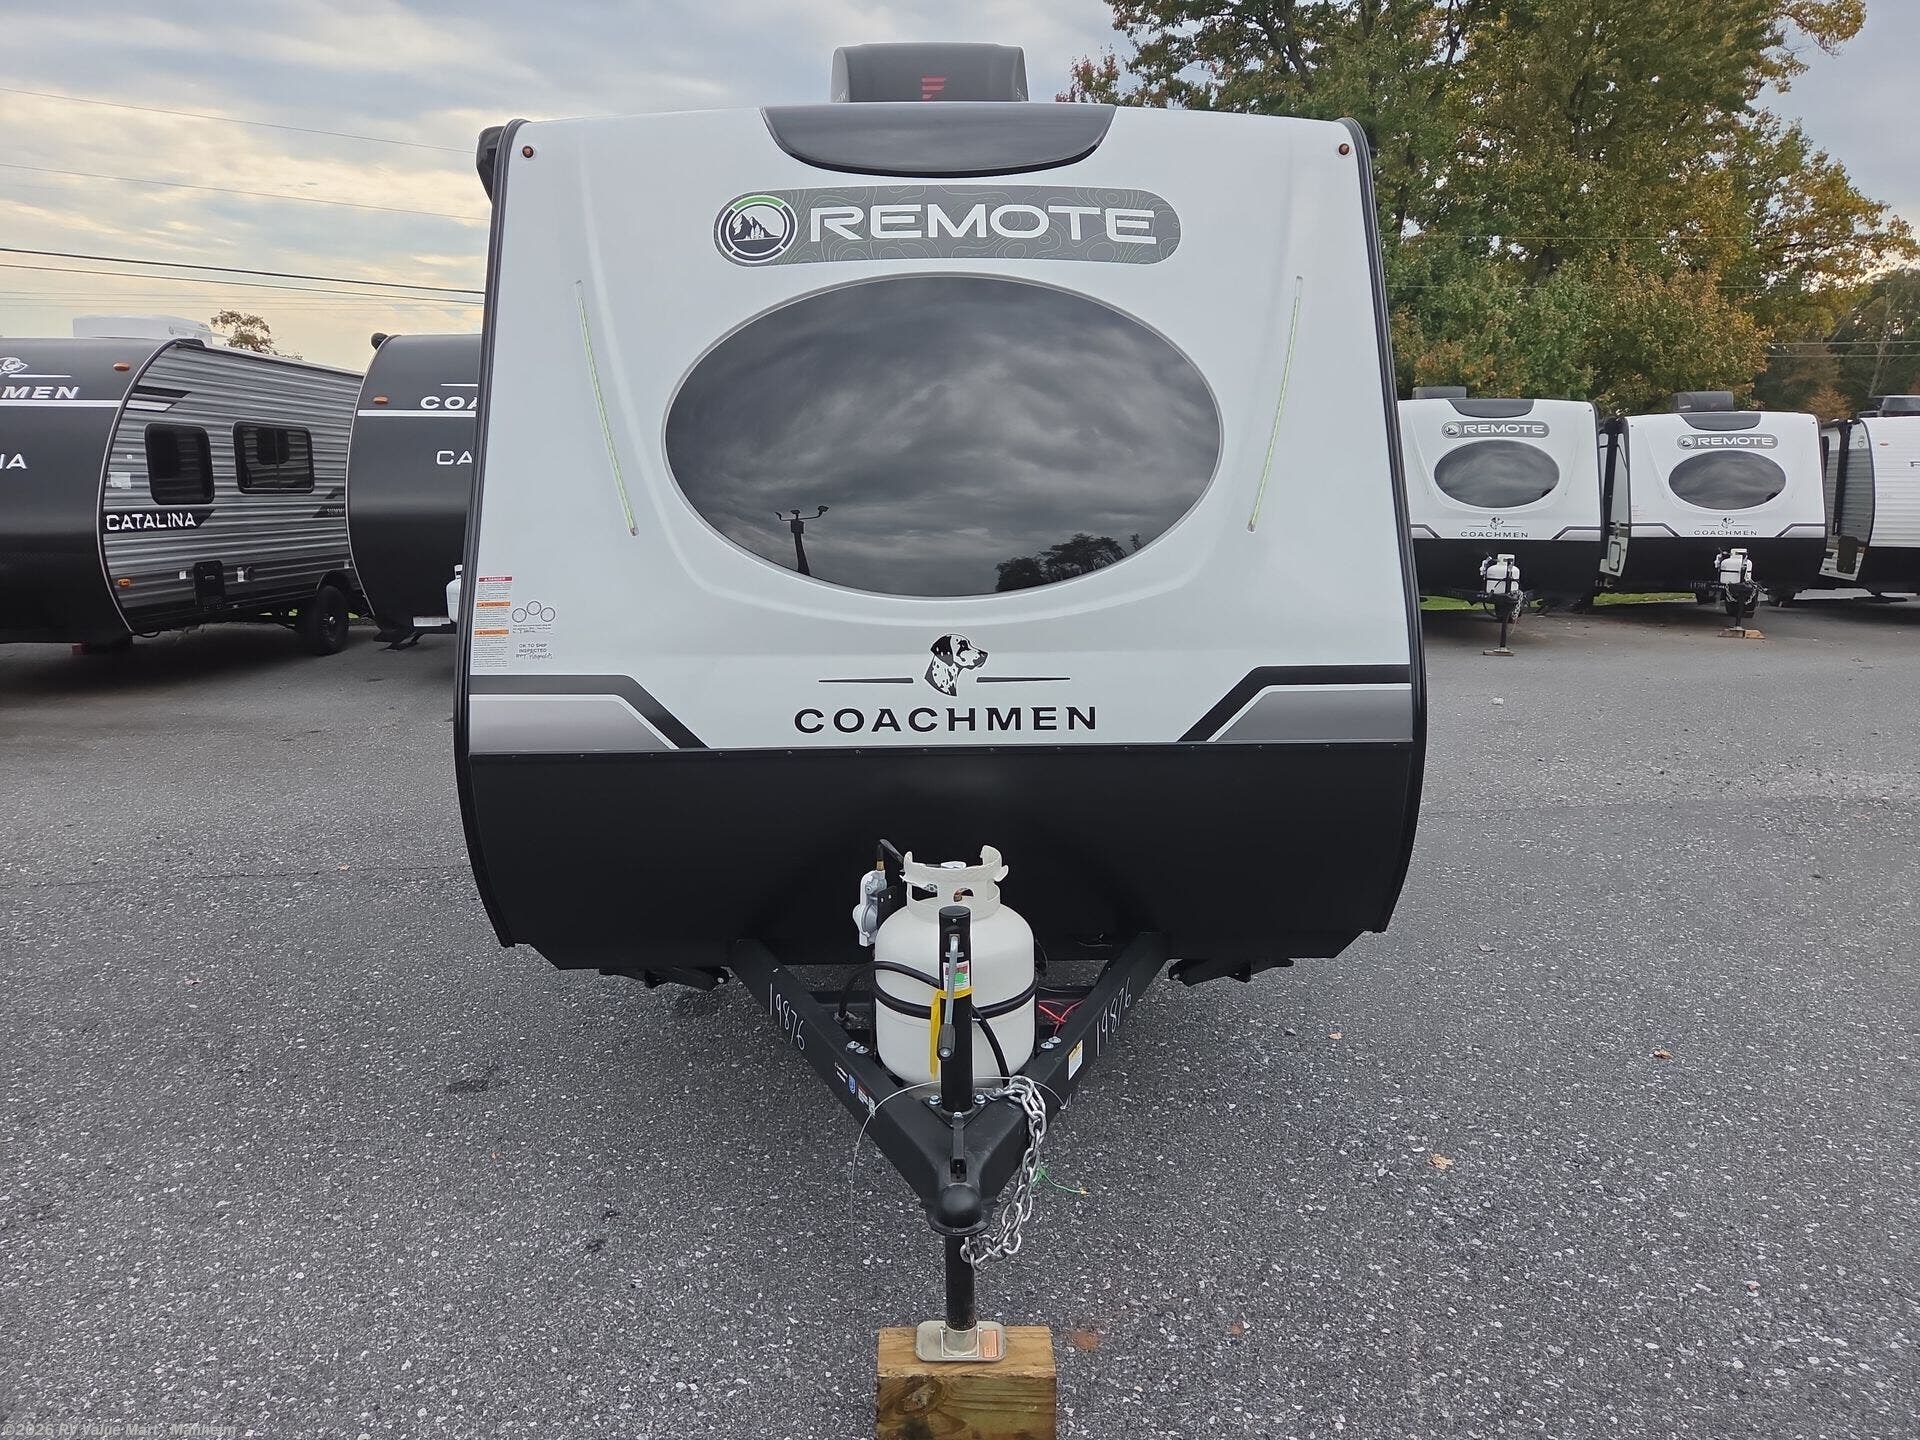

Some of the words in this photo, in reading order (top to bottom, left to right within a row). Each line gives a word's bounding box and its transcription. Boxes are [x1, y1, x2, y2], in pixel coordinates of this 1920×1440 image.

[810, 204, 1157, 244] REMOTE
[1, 386, 80, 399] MEN
[1463, 424, 1545, 434] REMOTE
[1698, 437, 1774, 446] REMOTE
[436, 450, 473, 466] CA
[105, 512, 198, 531] CATALINA
[794, 706, 1096, 734] COACHMEN
